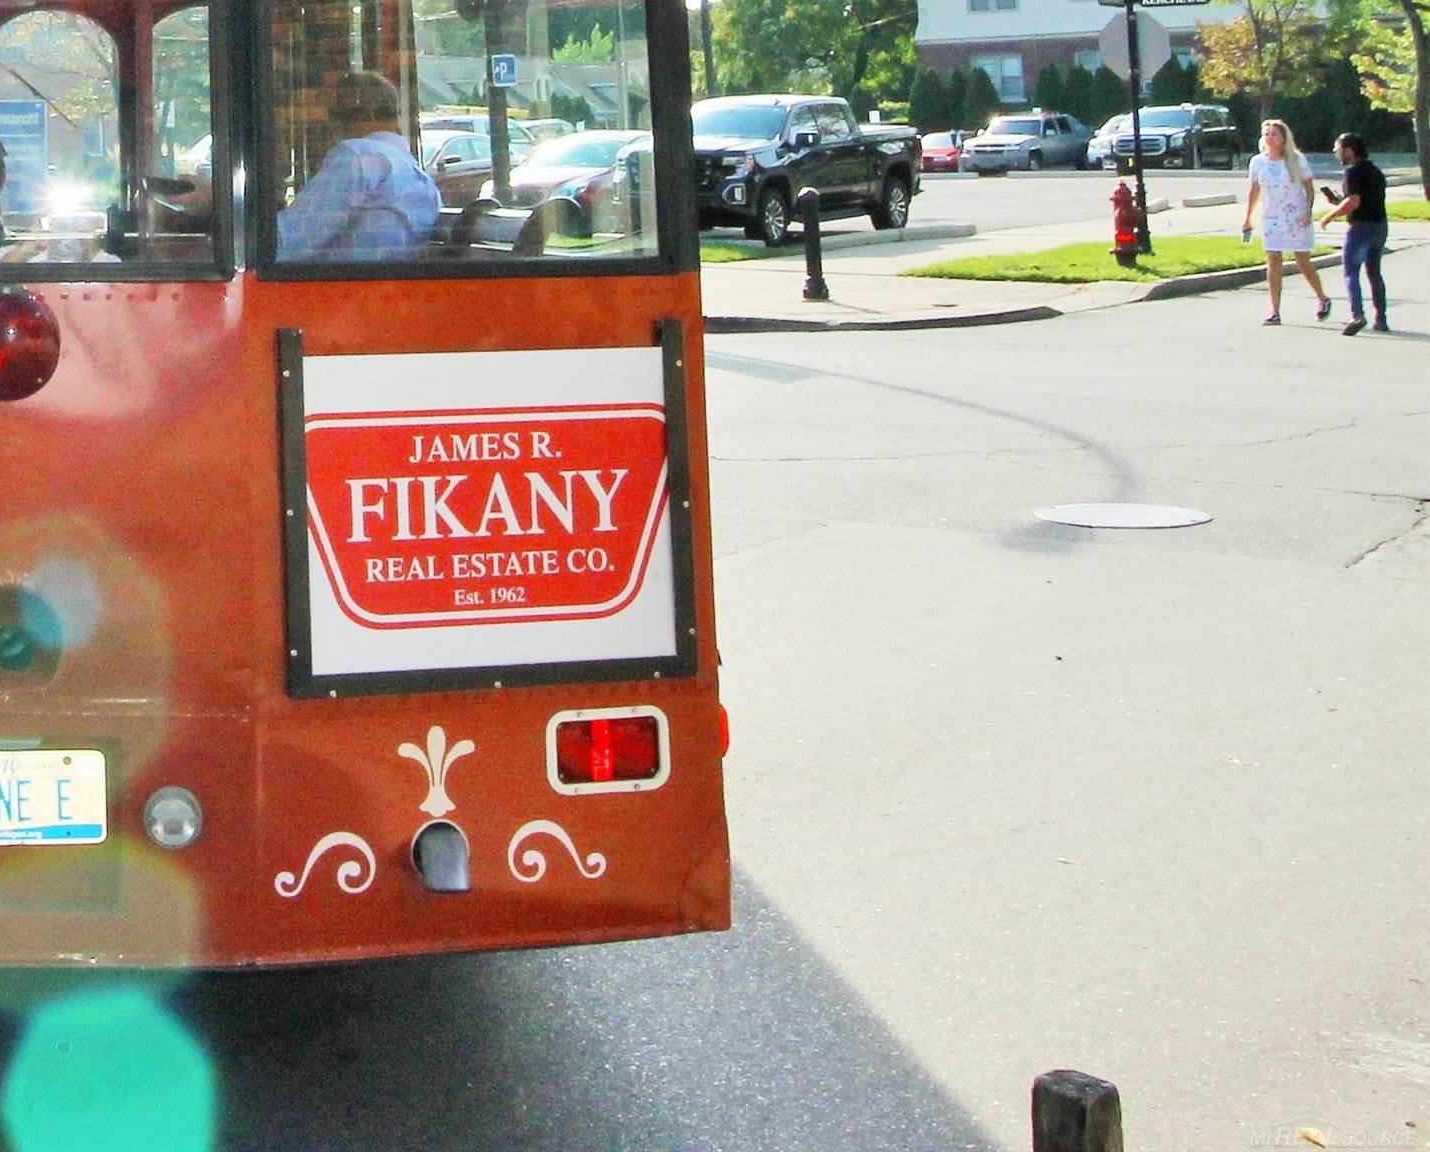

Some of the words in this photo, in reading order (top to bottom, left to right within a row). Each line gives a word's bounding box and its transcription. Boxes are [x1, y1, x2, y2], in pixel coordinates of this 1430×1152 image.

[408, 431, 521, 464] JAMES
[530, 431, 562, 459] R.
[345, 468, 629, 543] FIKANY
[365, 555, 445, 583] REAL
[451, 549, 560, 579] ESTATE
[566, 547, 615, 574] CO.
[453, 588, 485, 606] Est.
[490, 586, 526, 604] 1962
[57, 778, 73, 821] E
